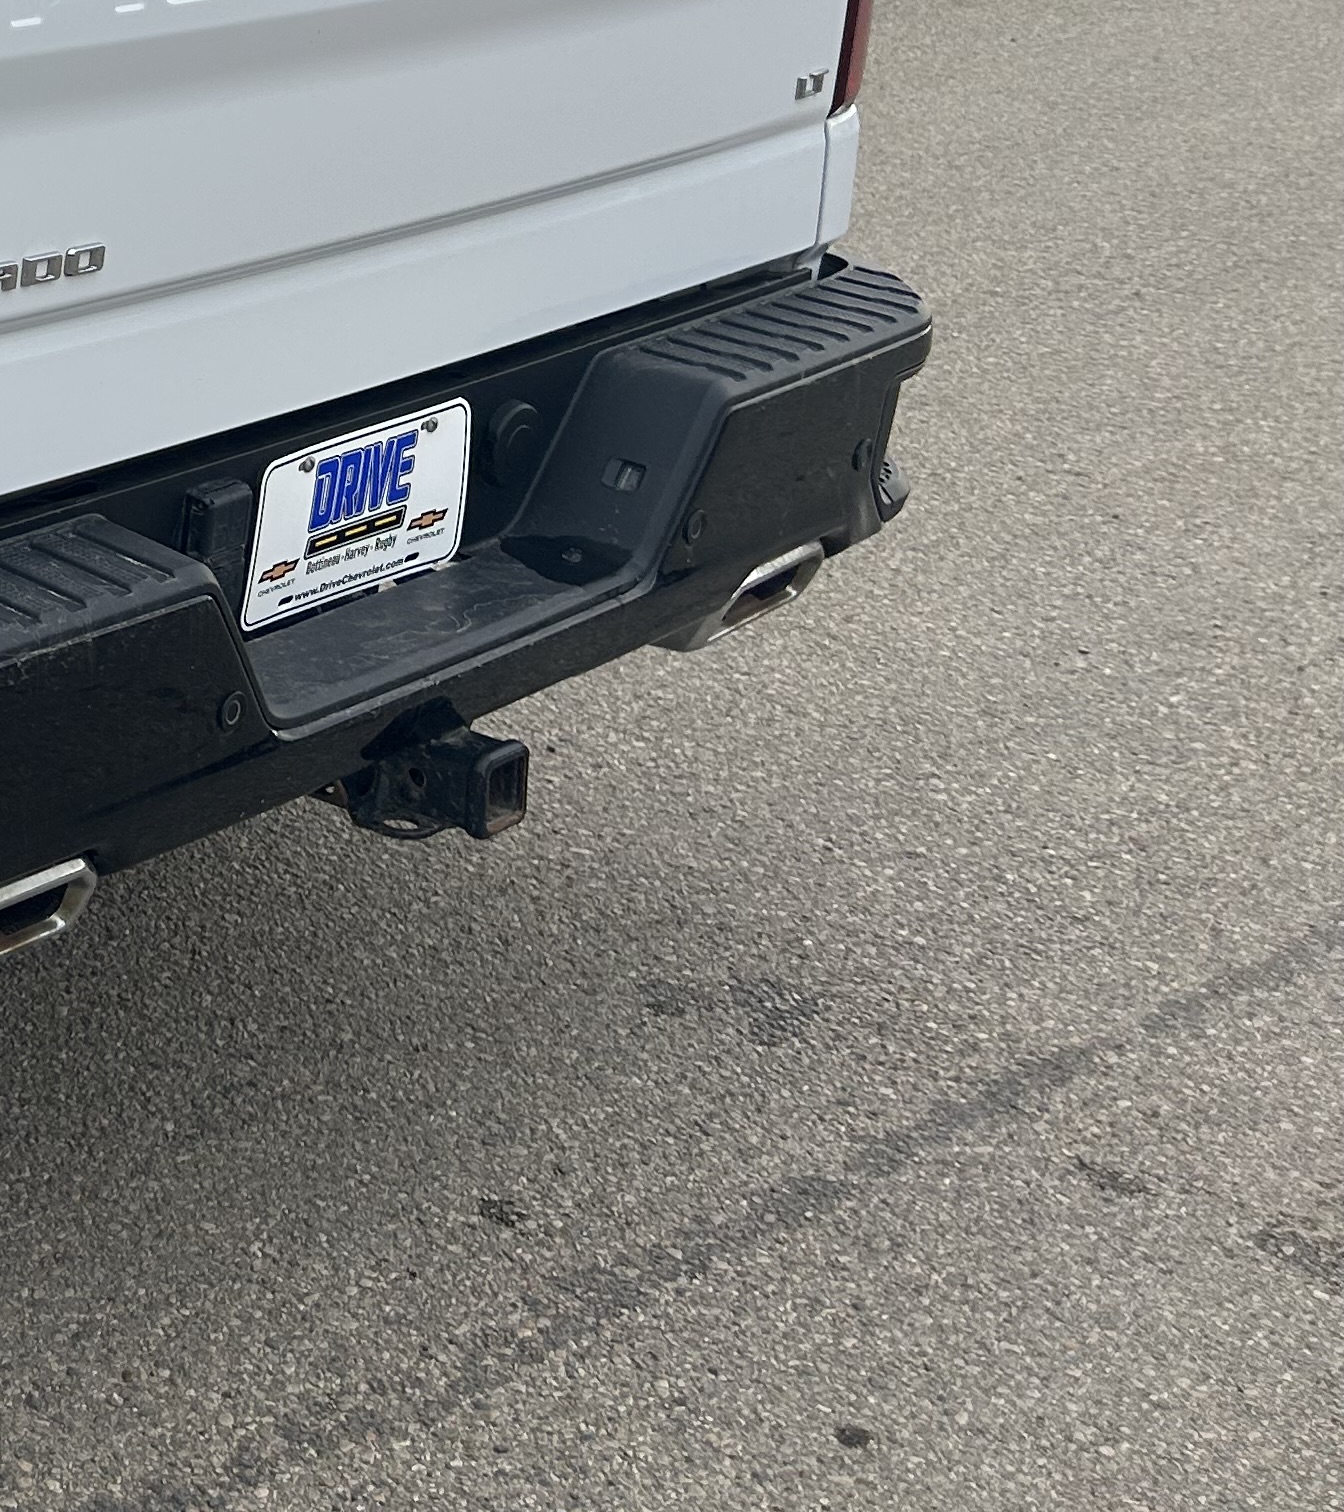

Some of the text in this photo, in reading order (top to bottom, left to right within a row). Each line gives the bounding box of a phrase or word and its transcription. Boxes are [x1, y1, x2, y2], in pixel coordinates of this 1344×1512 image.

[795, 67, 830, 100] LT
[307, 429, 419, 533] DRIVE
[344, 543, 370, 562] Harvey
[374, 533, 398, 552] Rugby
[406, 527, 445, 545] CHEVROLET
[257, 577, 296, 598] CHEVROLET
[294, 557, 405, 602] www.DriveChevrolet.com
